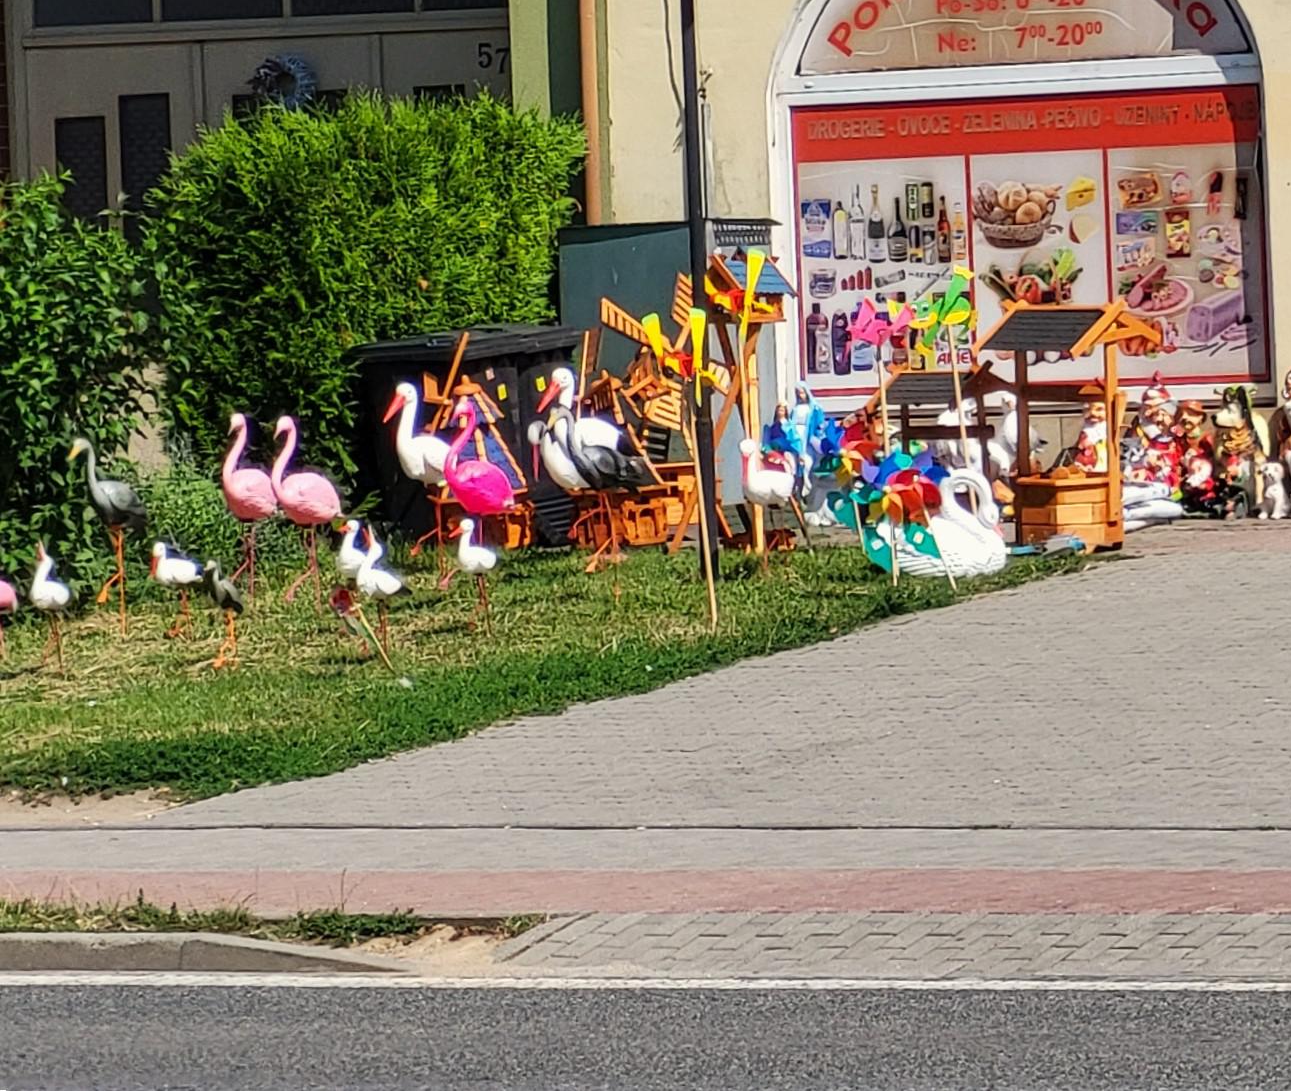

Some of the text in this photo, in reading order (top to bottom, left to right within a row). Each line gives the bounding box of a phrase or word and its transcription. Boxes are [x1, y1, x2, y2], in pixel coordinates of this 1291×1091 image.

[938, 31, 977, 53] Ne:
[477, 42, 510, 75] 57
[808, 118, 886, 141] DROGERIE
[897, 115, 951, 137] OVOCE
[963, 111, 1037, 133] ZELENINA
